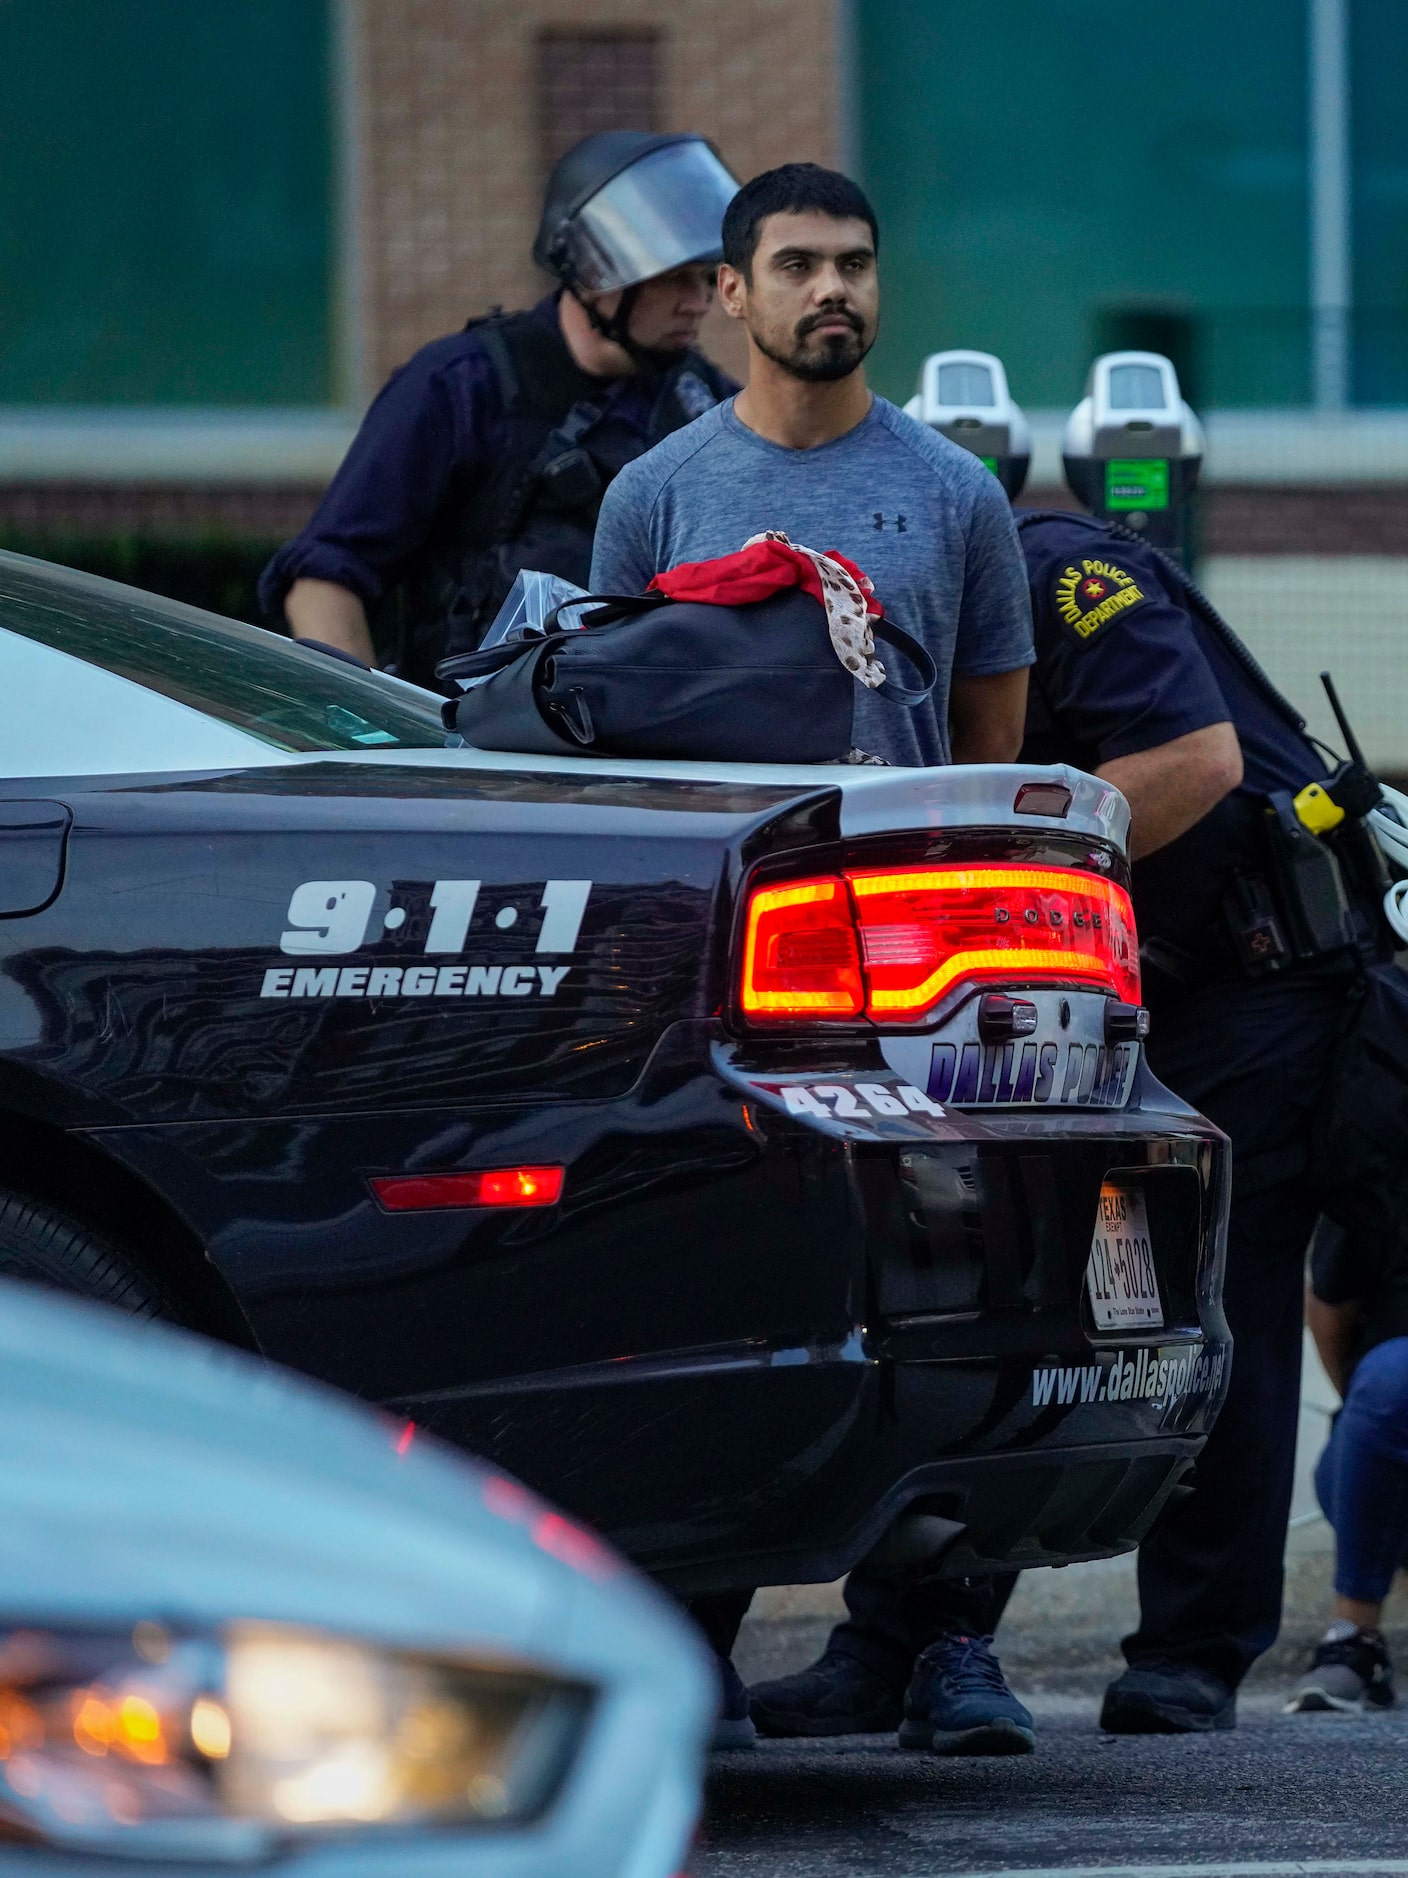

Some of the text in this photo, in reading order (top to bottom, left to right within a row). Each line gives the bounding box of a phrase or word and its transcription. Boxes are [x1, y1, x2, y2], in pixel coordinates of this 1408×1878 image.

[1055, 559, 1136, 624] DALLAS POLICE
[1073, 584, 1145, 638] DEPARTMENT
[995, 907, 1102, 929] DODGE
[259, 965, 572, 998] EMERGENCY
[926, 1041, 1132, 1105] DALLAS POLICE
[779, 1083, 948, 1118] 4264
[1100, 1197, 1127, 1222] TEXAS
[1032, 1343, 1226, 1407] www.dallaspolice.net
